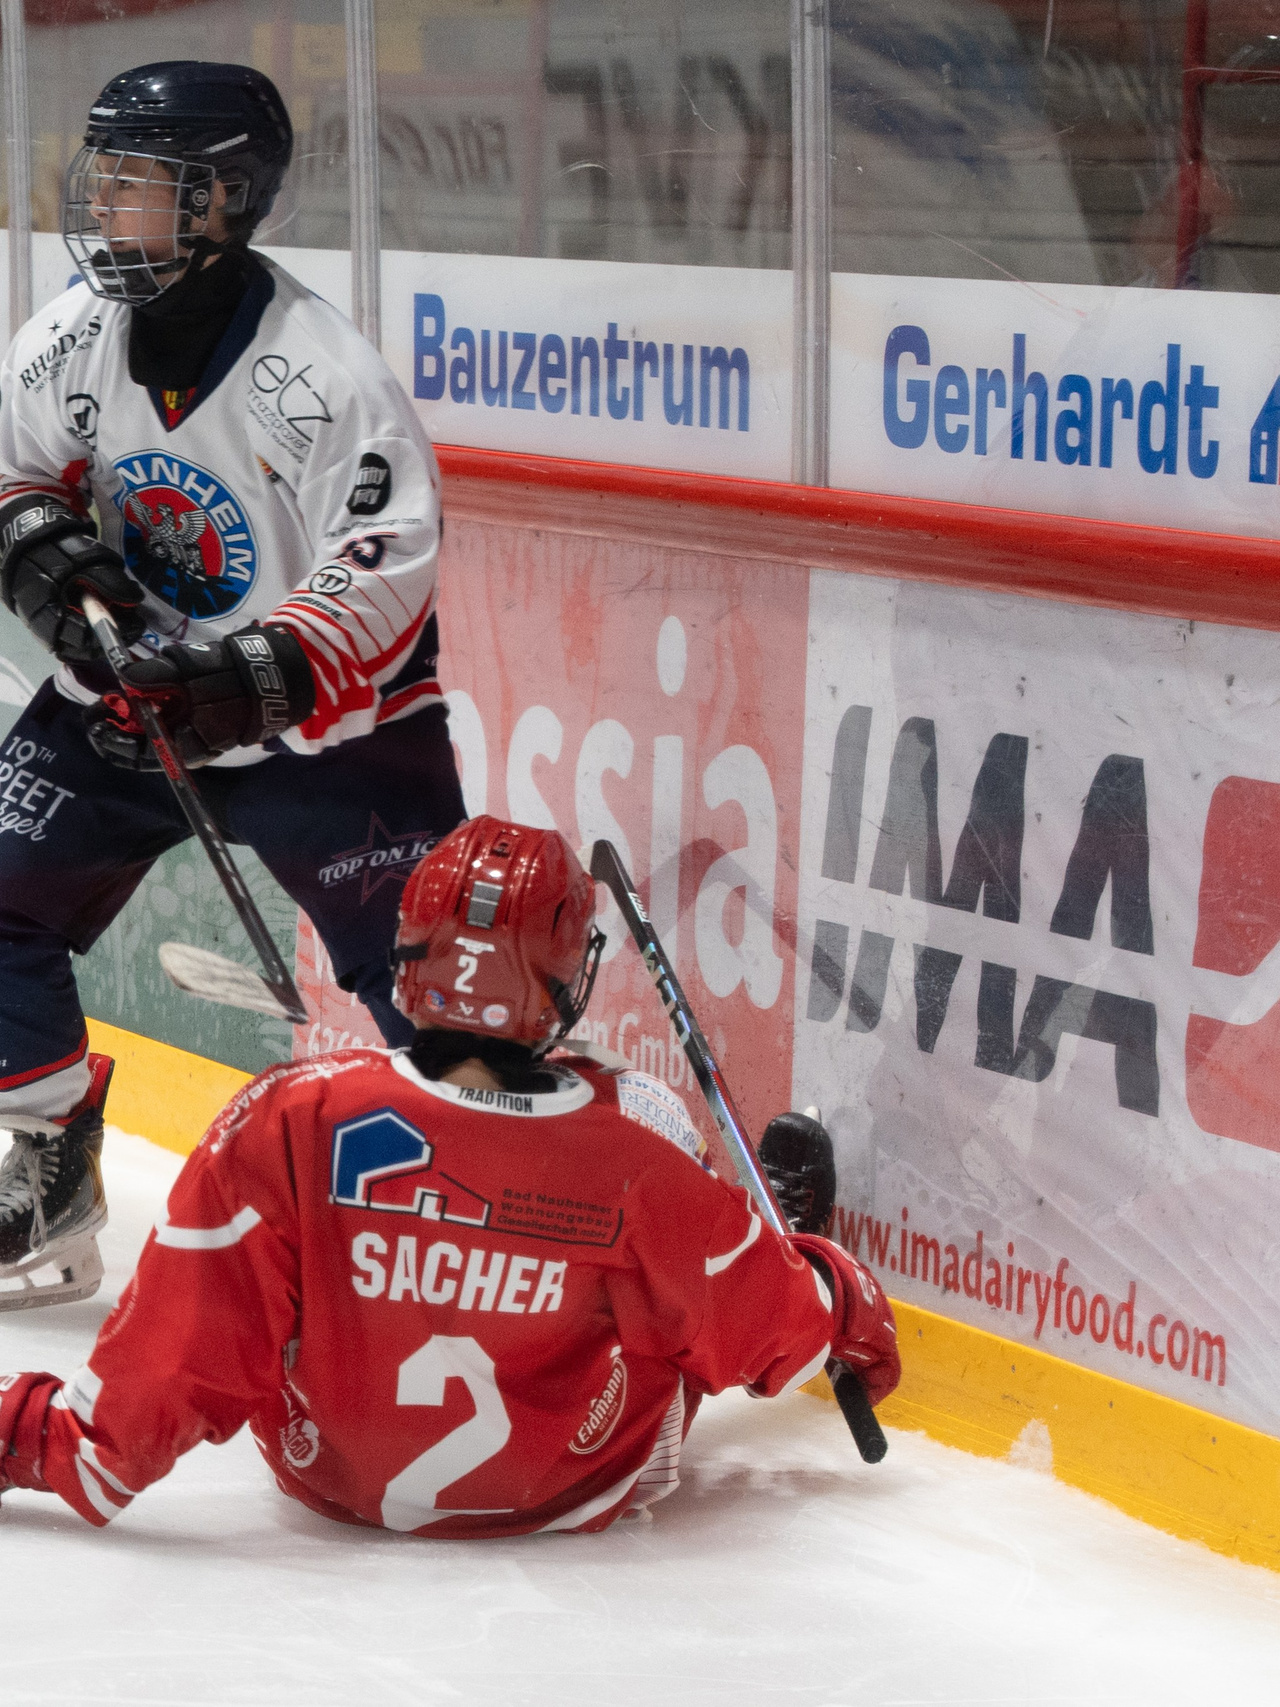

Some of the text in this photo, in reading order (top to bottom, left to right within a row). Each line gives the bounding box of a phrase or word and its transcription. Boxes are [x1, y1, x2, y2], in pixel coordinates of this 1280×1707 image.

[413, 293, 751, 432] Bauzentrum
[883, 324, 1220, 479] Gerhardt
[323, 840, 437, 884] TOP ON IC
[454, 954, 478, 994] 2
[458, 1087, 533, 1113] TRADITION
[503, 1188, 531, 1201] Bad
[351, 1232, 568, 1313] SACHER
[380, 1333, 513, 1532] 2
[577, 1368, 623, 1444] Eidmann
